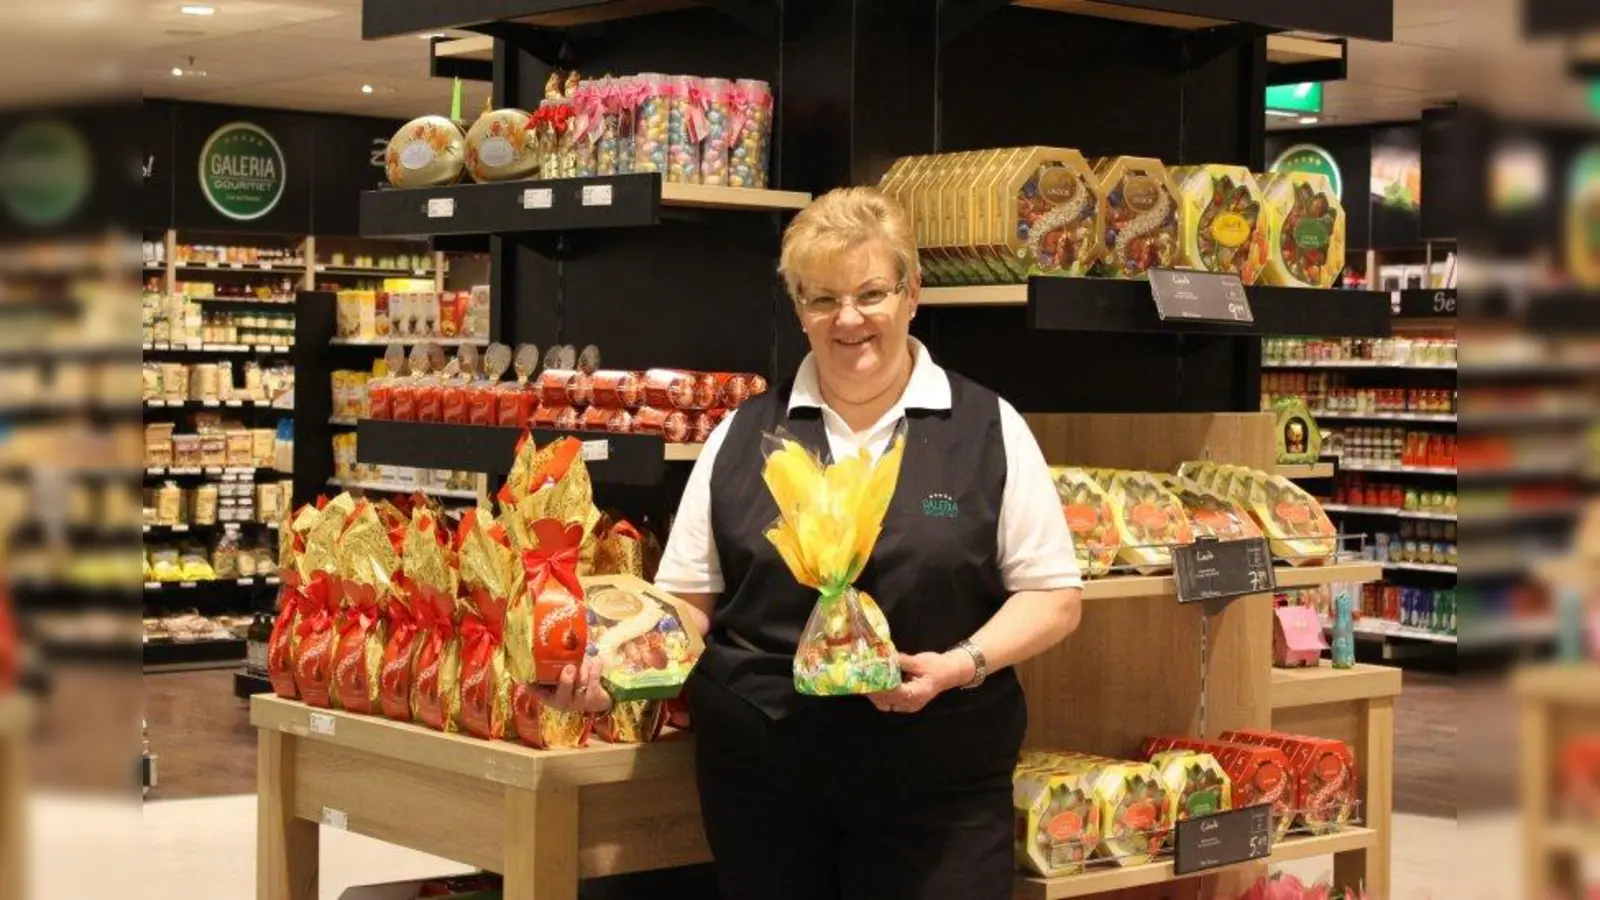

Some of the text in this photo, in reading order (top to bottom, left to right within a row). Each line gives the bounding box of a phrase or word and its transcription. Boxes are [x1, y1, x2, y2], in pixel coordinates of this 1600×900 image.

[211, 153, 276, 178] GALERIA
[214, 180, 273, 192] GOURMET
[922, 497, 959, 512] GALERIA
